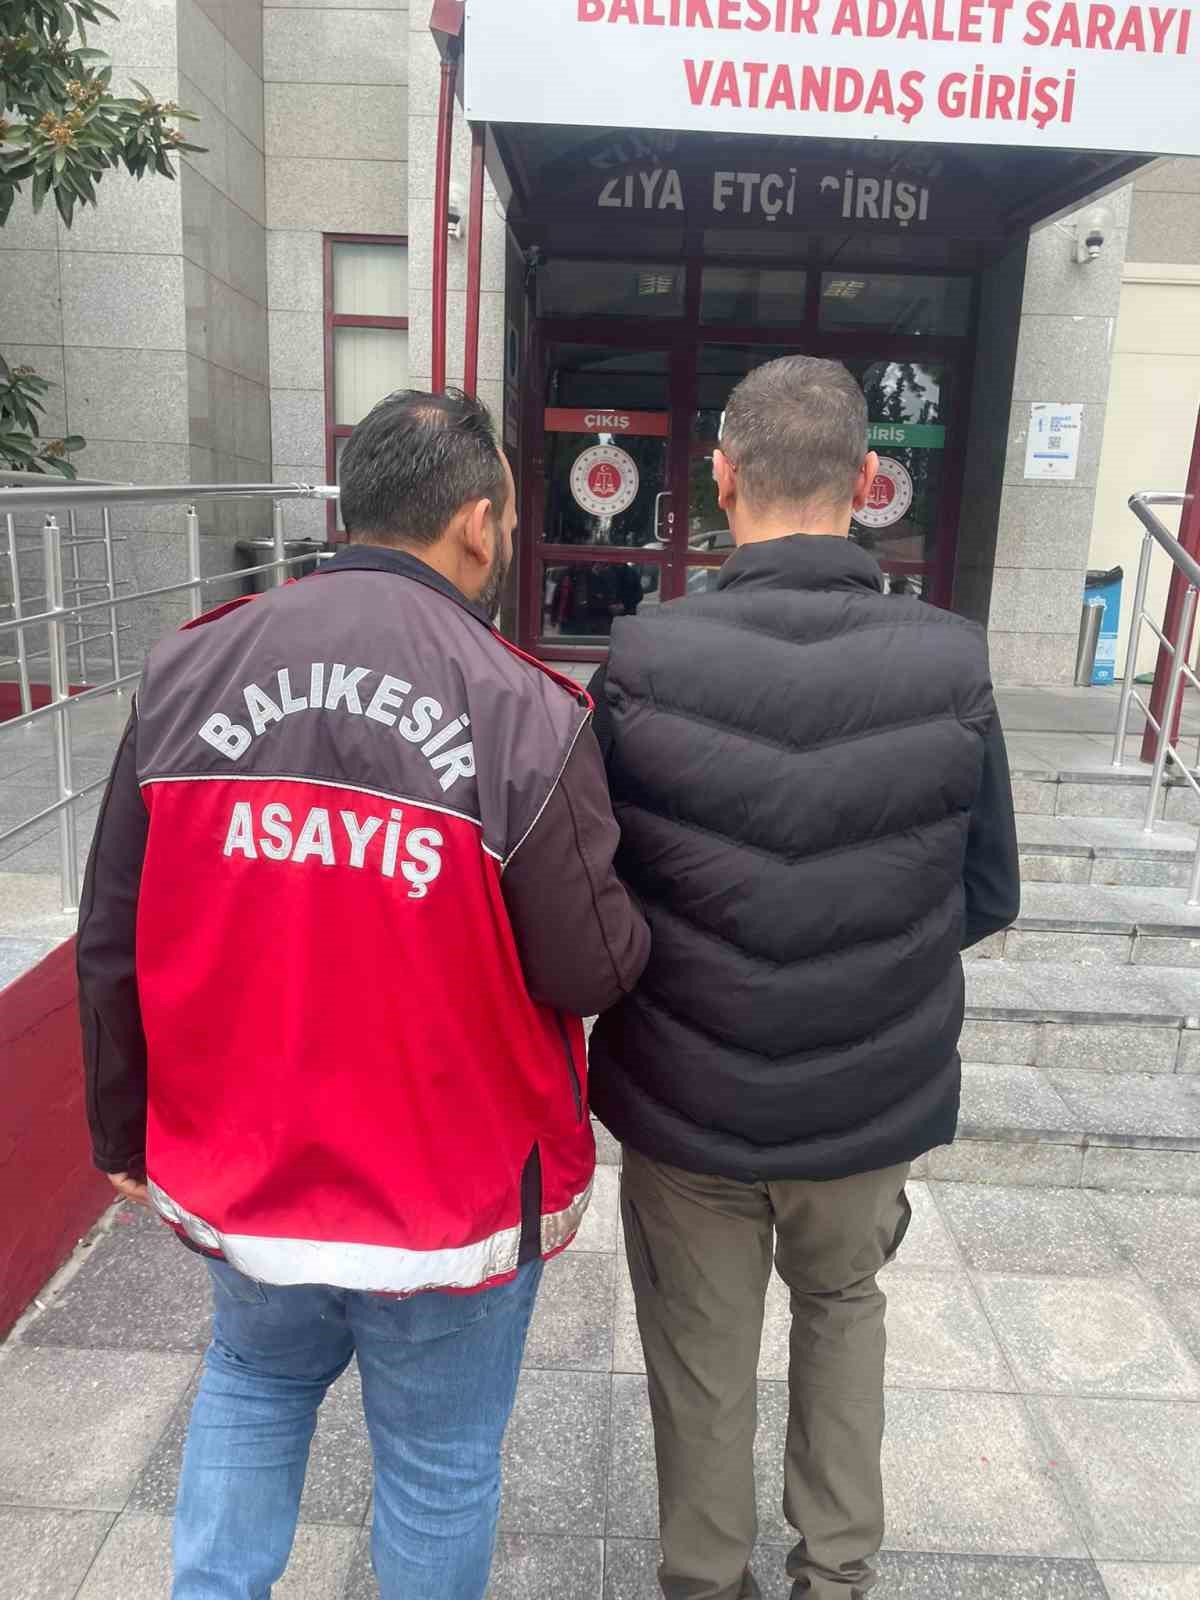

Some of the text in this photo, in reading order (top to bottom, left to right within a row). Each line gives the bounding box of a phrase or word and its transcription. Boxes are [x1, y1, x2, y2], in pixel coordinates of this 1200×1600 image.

[832, 0, 1013, 43] ADALET
[1023, 1, 1192, 54] SARAYI
[683, 59, 1076, 129] VATANDAŞ GİRİŞİ
[584, 414, 630, 429] ÇIKIŞ
[198, 662, 478, 792] BALIKESİR
[222, 801, 444, 898] ASAYİŞ
